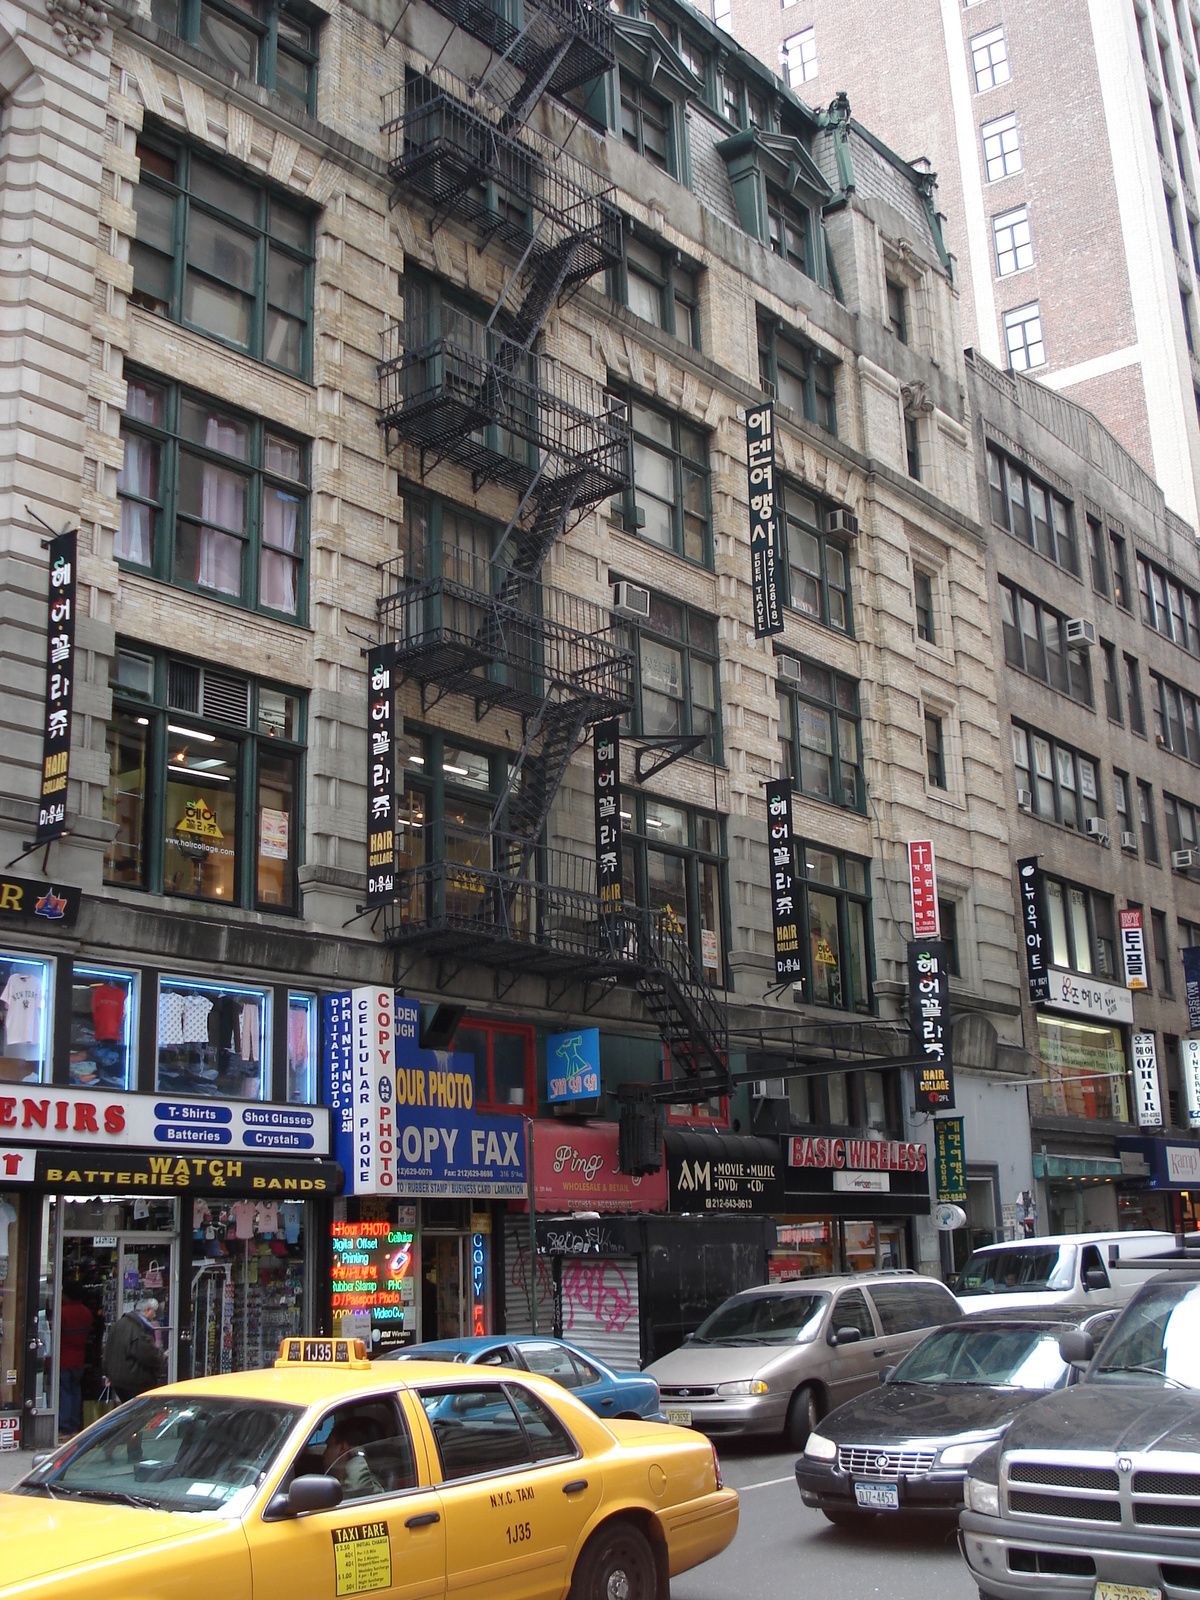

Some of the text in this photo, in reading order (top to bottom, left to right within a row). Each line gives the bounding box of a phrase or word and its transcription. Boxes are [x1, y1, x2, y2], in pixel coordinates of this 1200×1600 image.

[748, 409, 775, 548] 에덴여행사
[767, 549, 778, 620] 947-2848
[755, 585, 765, 631] TRAVEL
[45, 751, 68, 778] HAIR
[43, 775, 67, 795] COLLAGE
[39, 803, 65, 826] 미용실
[165, 837, 235, 856] www.haircollage.com
[370, 830, 393, 853] HAIR
[369, 851, 394, 867] COLLAGE
[369, 875, 393, 893] 미용실
[776, 924, 797, 940] HAIR
[1024, 883, 1042, 970] 뉴욕아트
[776, 940, 799, 952] COLLAGE
[777, 958, 800, 973] 미용실
[377, 993, 391, 1064] COPY
[341, 997, 352, 1093] PRINTING
[1134, 1035, 1152, 1045] 오즈
[1135, 1046, 1154, 1055] 헤어
[1137, 1058, 1155, 1069] OZ
[923, 1069, 945, 1081] HAIR
[357, 1000, 371, 1182] CELLULAR PHONE
[428, 1070, 473, 1110] PHOTO
[920, 1081, 950, 1092] COLLAGE
[1140, 1071, 1155, 1111] HAIR
[938, 1094, 950, 1102] 2FL
[182, 1107, 217, 1121] Shirts
[244, 1109, 313, 1127] Shot Glasses
[167, 1127, 221, 1142] Batteries
[255, 1131, 300, 1146] Crystals
[379, 1107, 393, 1186] PHOTO
[471, 1129, 520, 1166] FAX
[790, 1136, 927, 1172] BASIC WIRELESS
[149, 1157, 242, 1178] WATCH
[553, 1145, 604, 1182] Ping
[717, 1163, 775, 1177] MOVIE MUSIC
[46, 1168, 328, 1191] BATTERIES & BANDS
[677, 1159, 711, 1192] AM
[408, 1182, 429, 1193] RUBBER
[430, 1183, 448, 1193] STAMP
[451, 1183, 476, 1194] BUSINESS
[477, 1184, 491, 1194] CARD
[494, 1184, 524, 1195] LAMINATION
[562, 1182, 630, 1192] WHOLESALE & RETAIL
[567, 1200, 634, 1209] CLOTHES ACCESSORIES
[360, 1222, 391, 1236] PHOTO
[388, 1231, 413, 1243] Cellular
[356, 1237, 378, 1249] Offset
[342, 1252, 369, 1266] Printing
[473, 1233, 483, 1296] COPY
[355, 1280, 377, 1293] Stamp
[473, 1304, 484, 1337] FA
[289, 1351, 301, 1360] DUTY
[305, 1343, 332, 1361] 1J35
[337, 1342, 347, 1351] OFF
[336, 1352, 348, 1360] DUTY
[490, 1486, 535, 1508] N.Y.C. TAXI
[336, 1522, 386, 1542] TAXI FARE
[506, 1522, 532, 1545] 1J35
